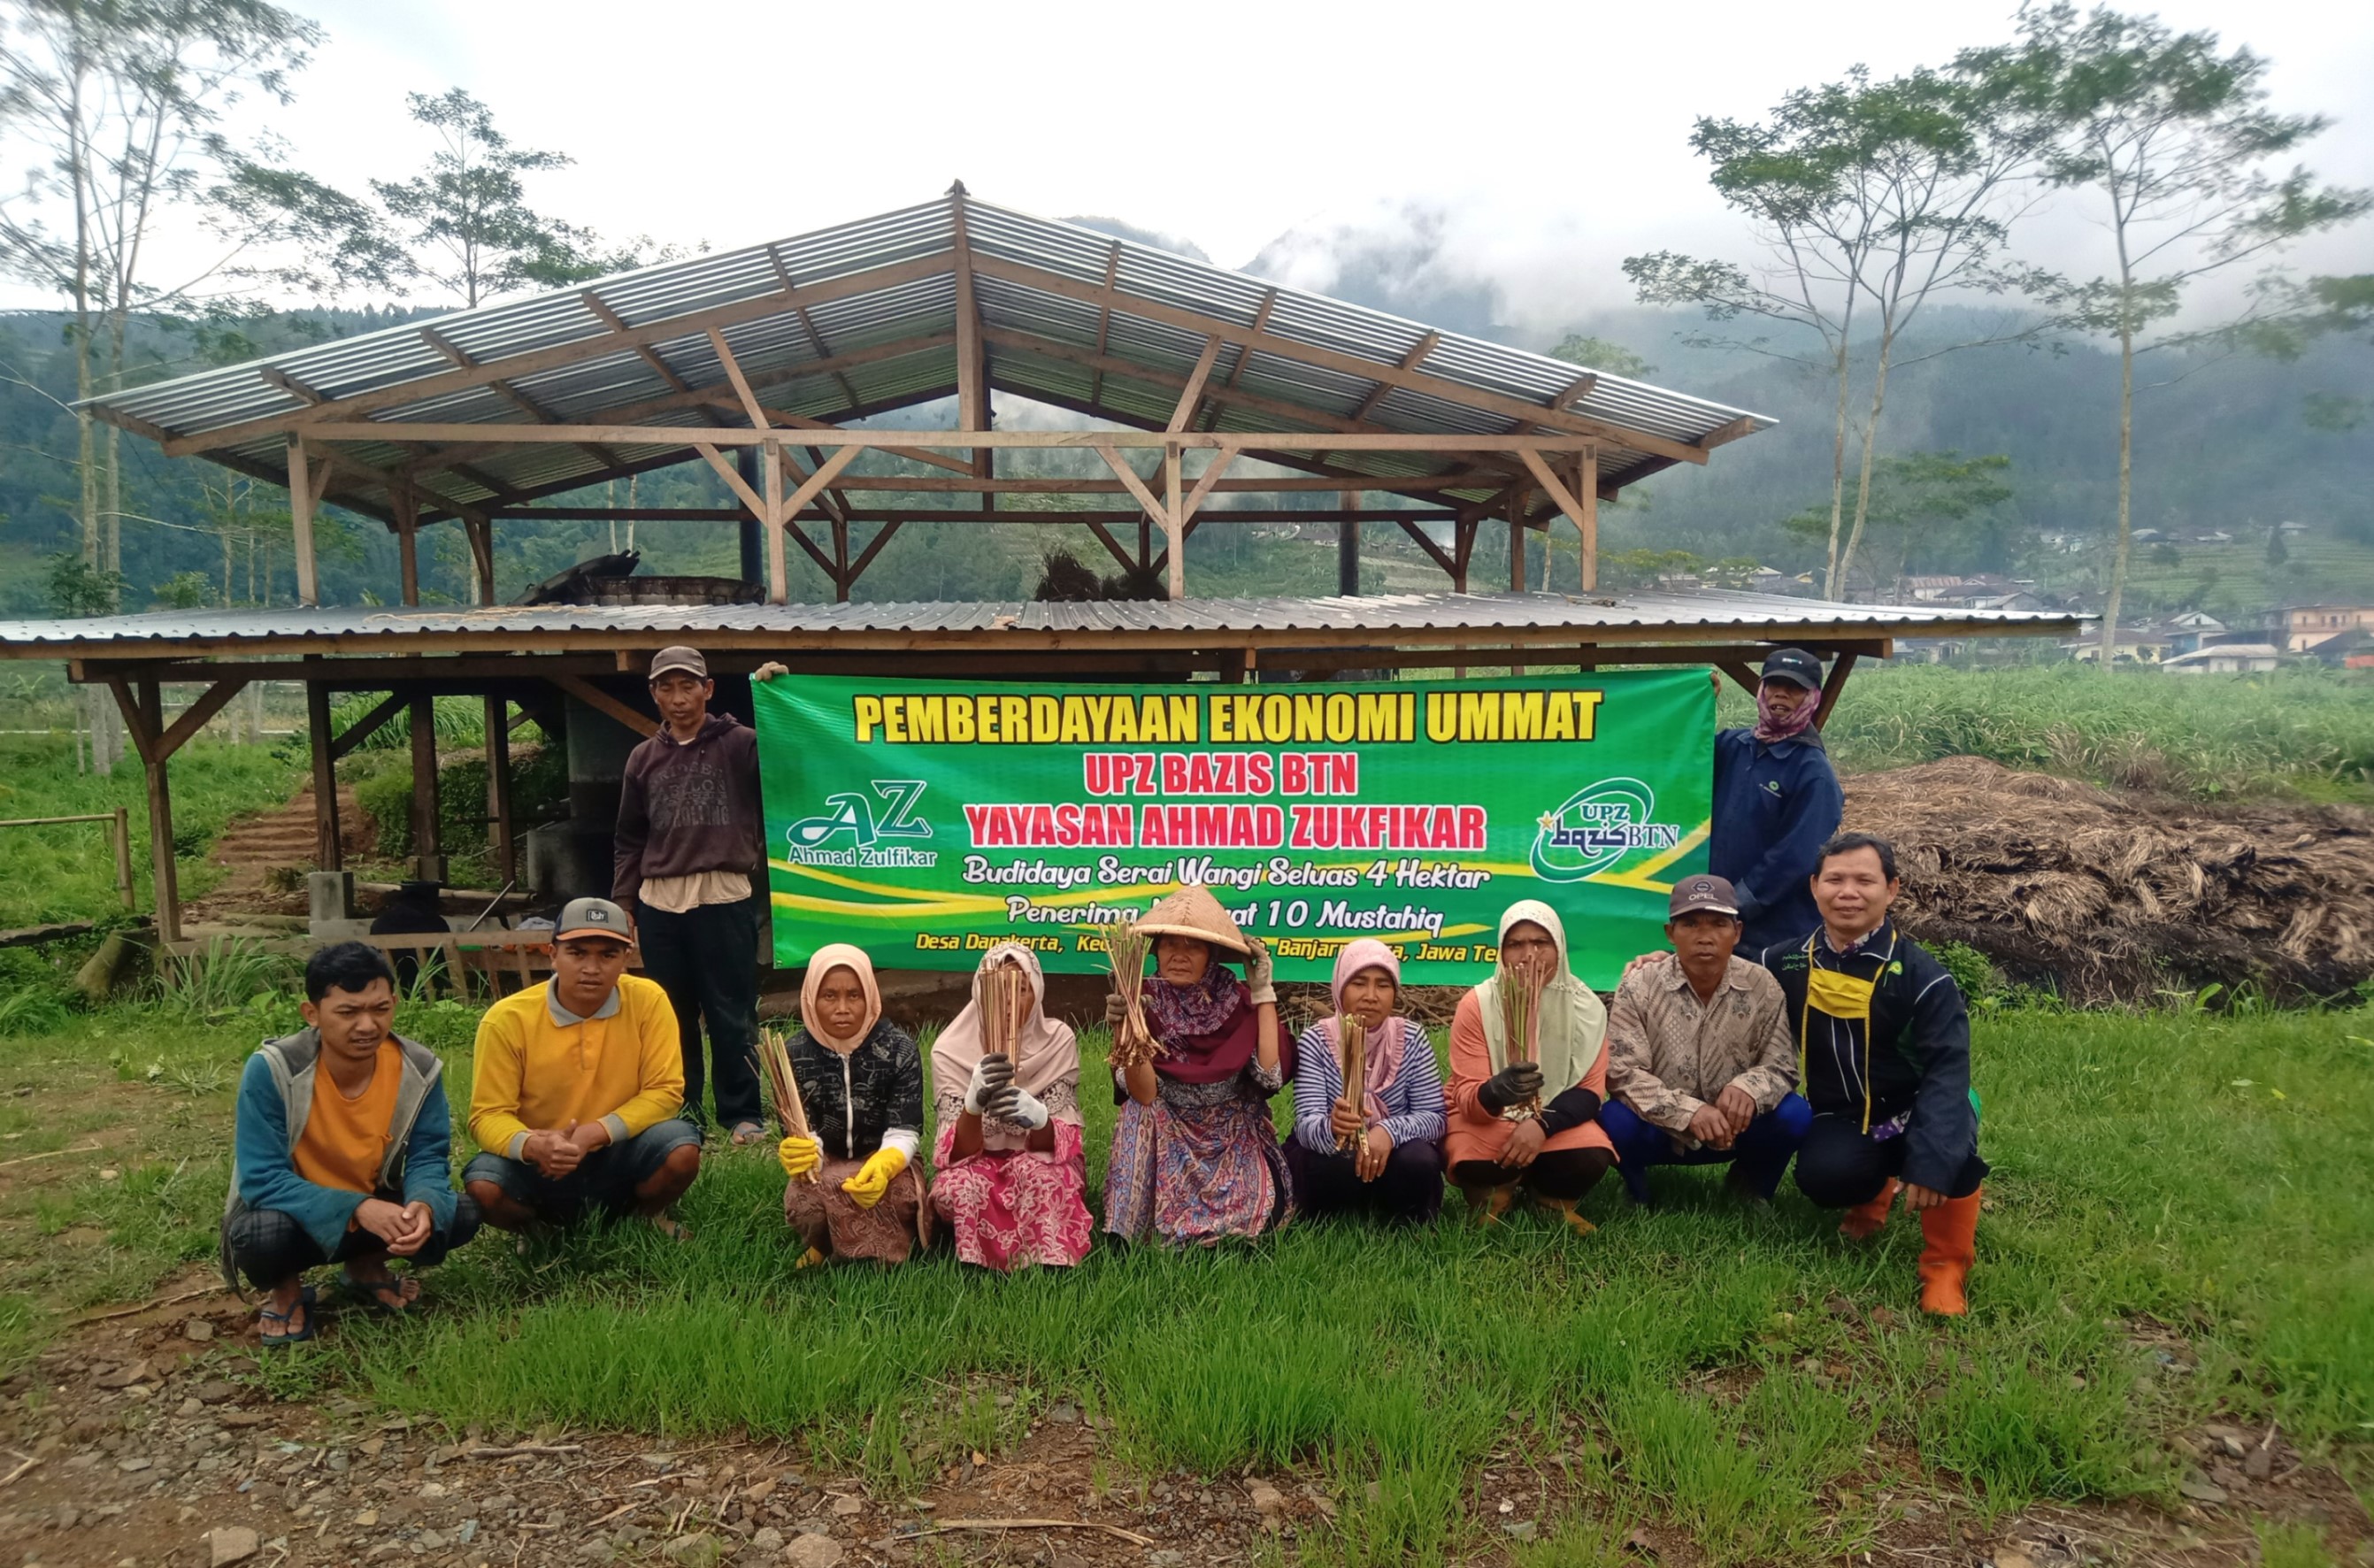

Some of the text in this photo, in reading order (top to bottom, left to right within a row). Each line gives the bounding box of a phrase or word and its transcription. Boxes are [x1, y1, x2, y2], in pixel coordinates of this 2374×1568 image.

[852, 690, 1603, 744] PEMBERDAYAAN EKONOMI UMMAT
[1084, 751, 1358, 796] UPZ BAZIS BTN
[787, 780, 933, 847] AZ
[964, 803, 1487, 851] YAYASAN AHMAD ZUKFIKAR
[1580, 803, 1630, 821] UPZ
[787, 846, 938, 867] Ahmad Zulfikar
[963, 855, 1491, 890] Budidaya Serai Wangi Seluas 4 Hektar
[1688, 892, 1718, 901] OPEL
[1005, 895, 1139, 924] Penerima
[1268, 900, 1310, 927] 10
[1315, 900, 1444, 939] Mustahiq
[915, 934, 961, 950] Desa
[1415, 942, 1468, 961] Jawa
